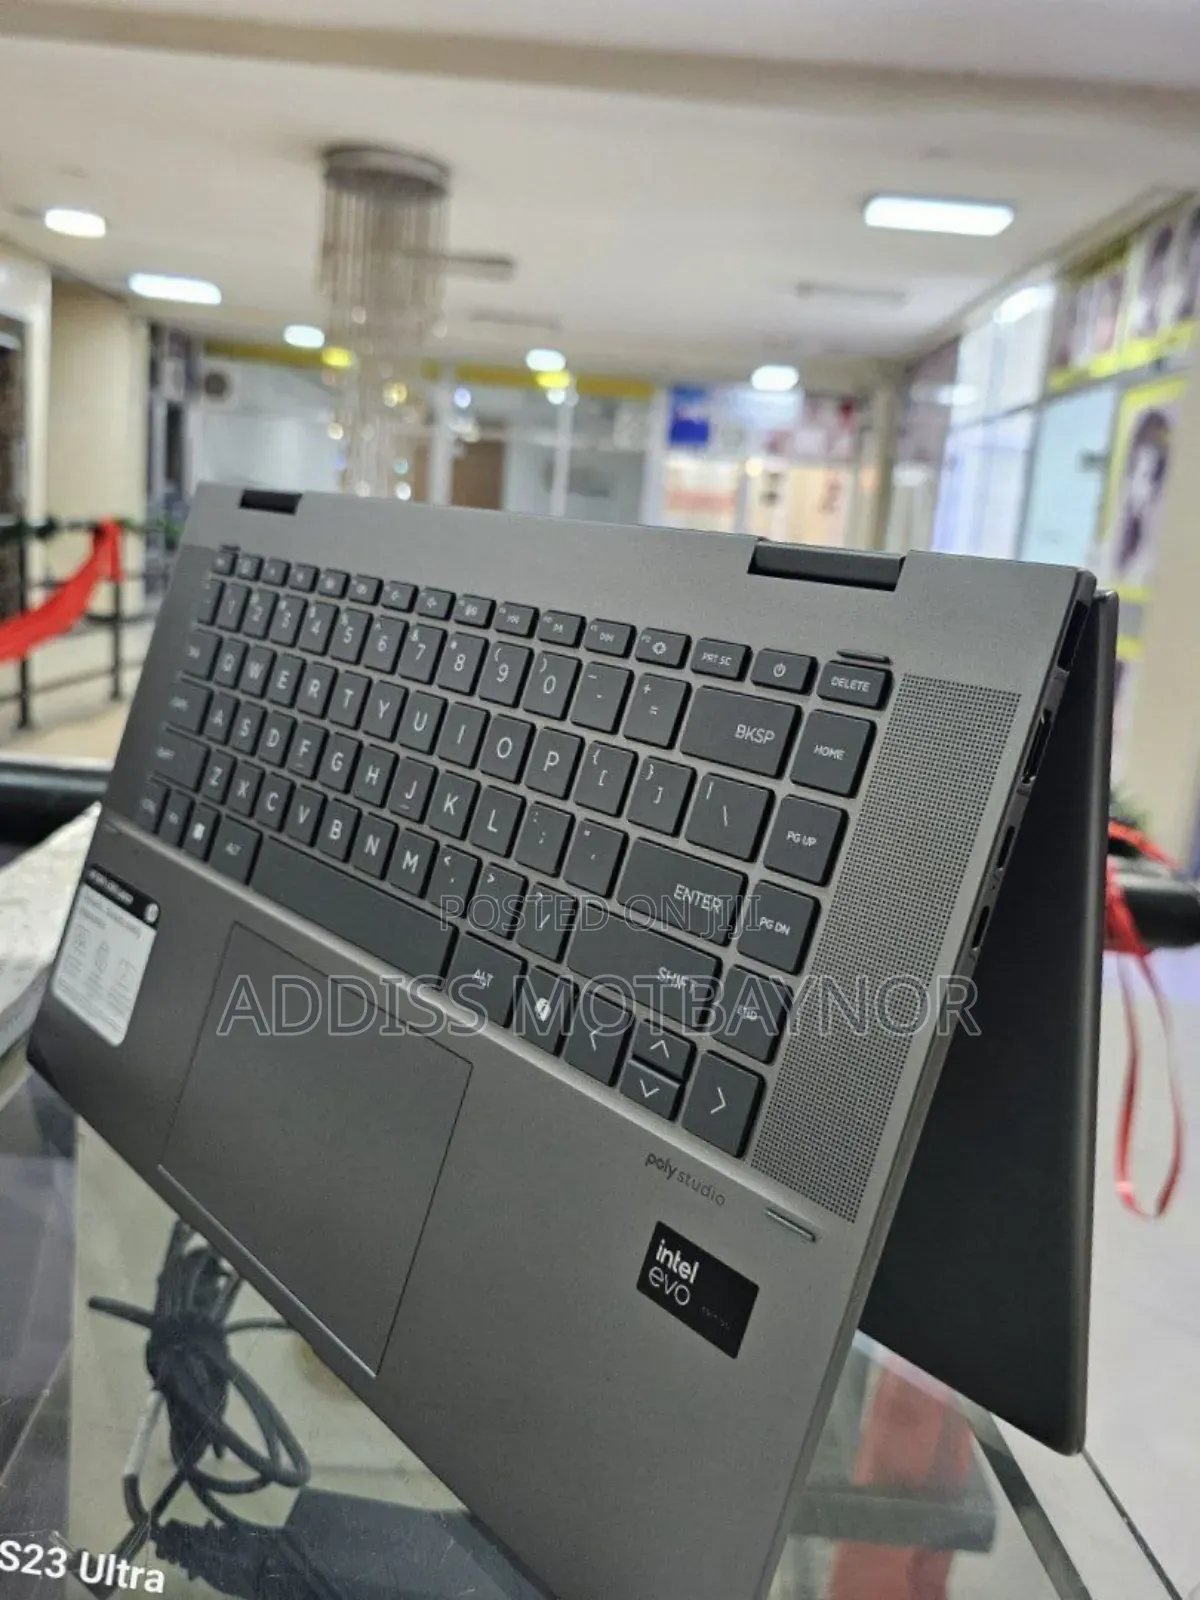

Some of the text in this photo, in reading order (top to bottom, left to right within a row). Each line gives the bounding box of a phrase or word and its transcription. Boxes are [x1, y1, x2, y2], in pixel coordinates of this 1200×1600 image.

[252, 605, 263, 622] 2
[282, 612, 291, 628] 3
[343, 627, 354, 644] 5
[377, 635, 388, 652] 6
[415, 643, 426, 661] 7
[454, 653, 466, 671] 8
[701, 652, 732, 666] PRT SC
[221, 653, 236, 673] Q
[248, 661, 264, 680] W
[496, 663, 509, 682] 9
[276, 670, 290, 690] E
[307, 679, 321, 699] R
[543, 675, 556, 694] 0
[830, 676, 871, 692] DELETE
[344, 688, 355, 709] T
[211, 709, 224, 727] A
[378, 699, 391, 719] Y
[239, 718, 251, 737] S
[413, 711, 428, 732] U
[265, 728, 280, 748] D
[734, 724, 776, 745] BKSP
[299, 738, 312, 757] F
[497, 737, 512, 759] O
[813, 744, 846, 761] HOME
[330, 751, 344, 772] G
[543, 751, 559, 771] P
[208, 766, 223, 787] Z
[365, 764, 380, 786] H
[237, 780, 251, 799] X
[404, 780, 417, 799] J
[267, 792, 279, 812] C
[443, 793, 459, 816] K
[297, 804, 311, 824] V
[486, 808, 498, 833] L
[329, 819, 343, 840] B
[786, 831, 817, 847] PG UP
[364, 834, 381, 856] N
[402, 850, 419, 874] M
[673, 883, 722, 914] ENTER
[759, 916, 791, 936] PG DN
[645, 1152, 726, 1206] poly studio
[655, 1238, 700, 1284] intel
[648, 1266, 691, 1306] evo
